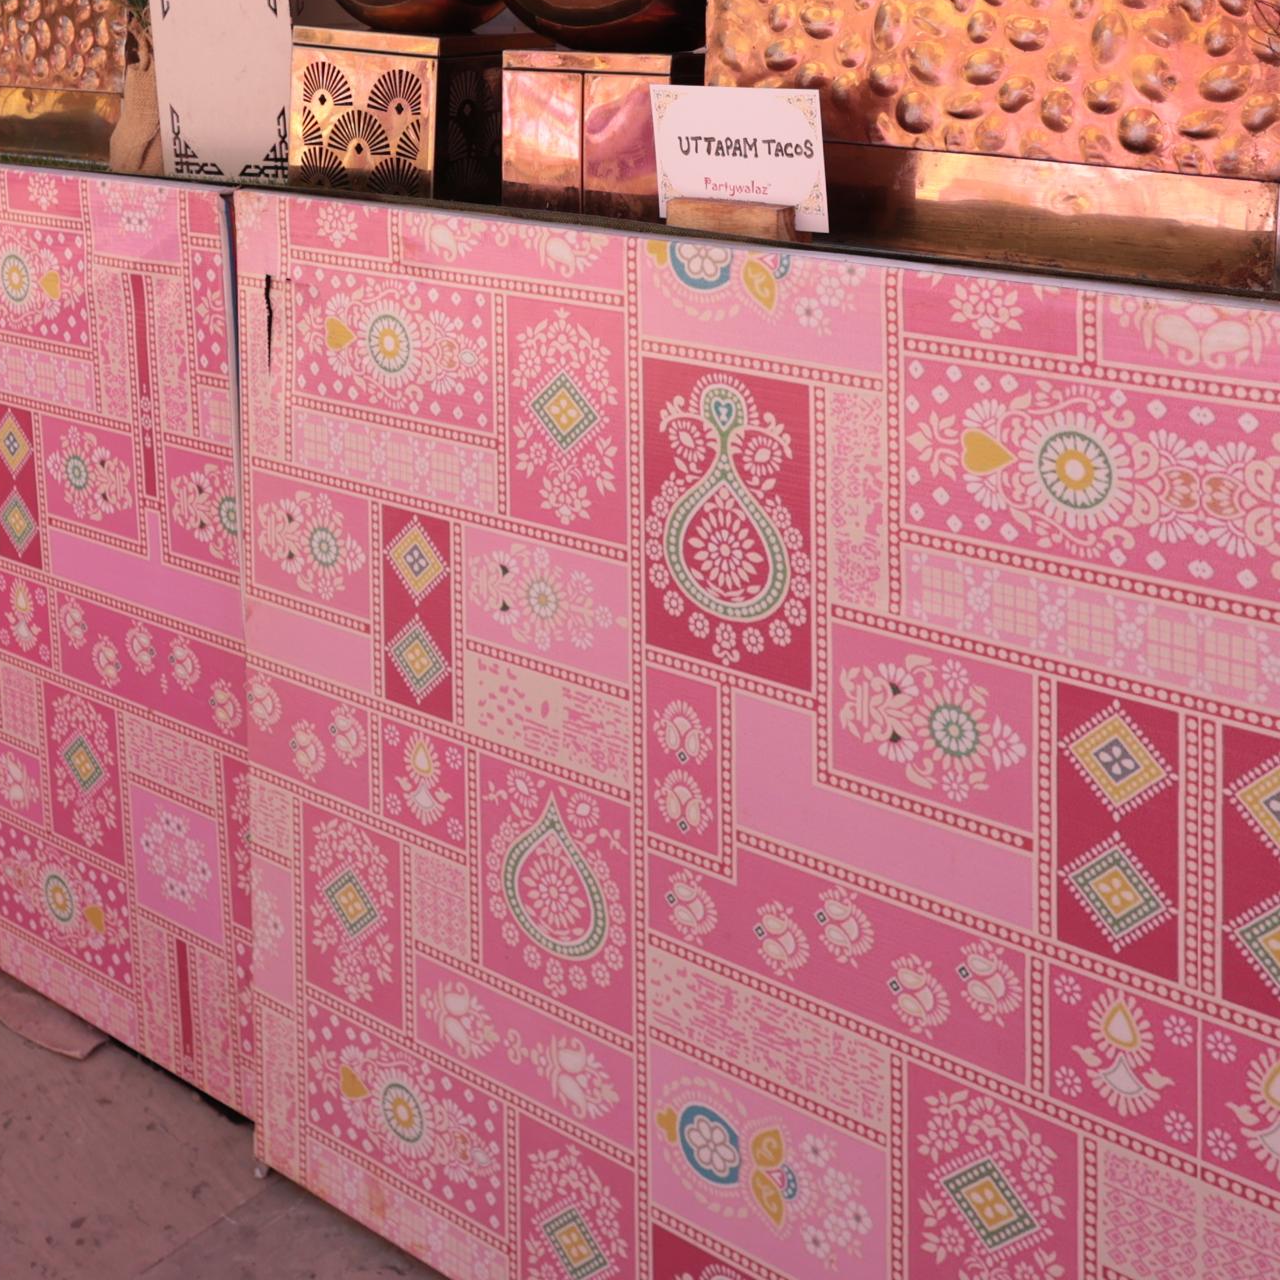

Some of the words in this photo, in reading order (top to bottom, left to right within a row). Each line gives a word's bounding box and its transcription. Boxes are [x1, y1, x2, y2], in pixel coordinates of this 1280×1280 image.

[677, 135, 758, 158] UTTAPAM
[761, 138, 814, 159] TACOS
[703, 176, 769, 197] Partywalaz
